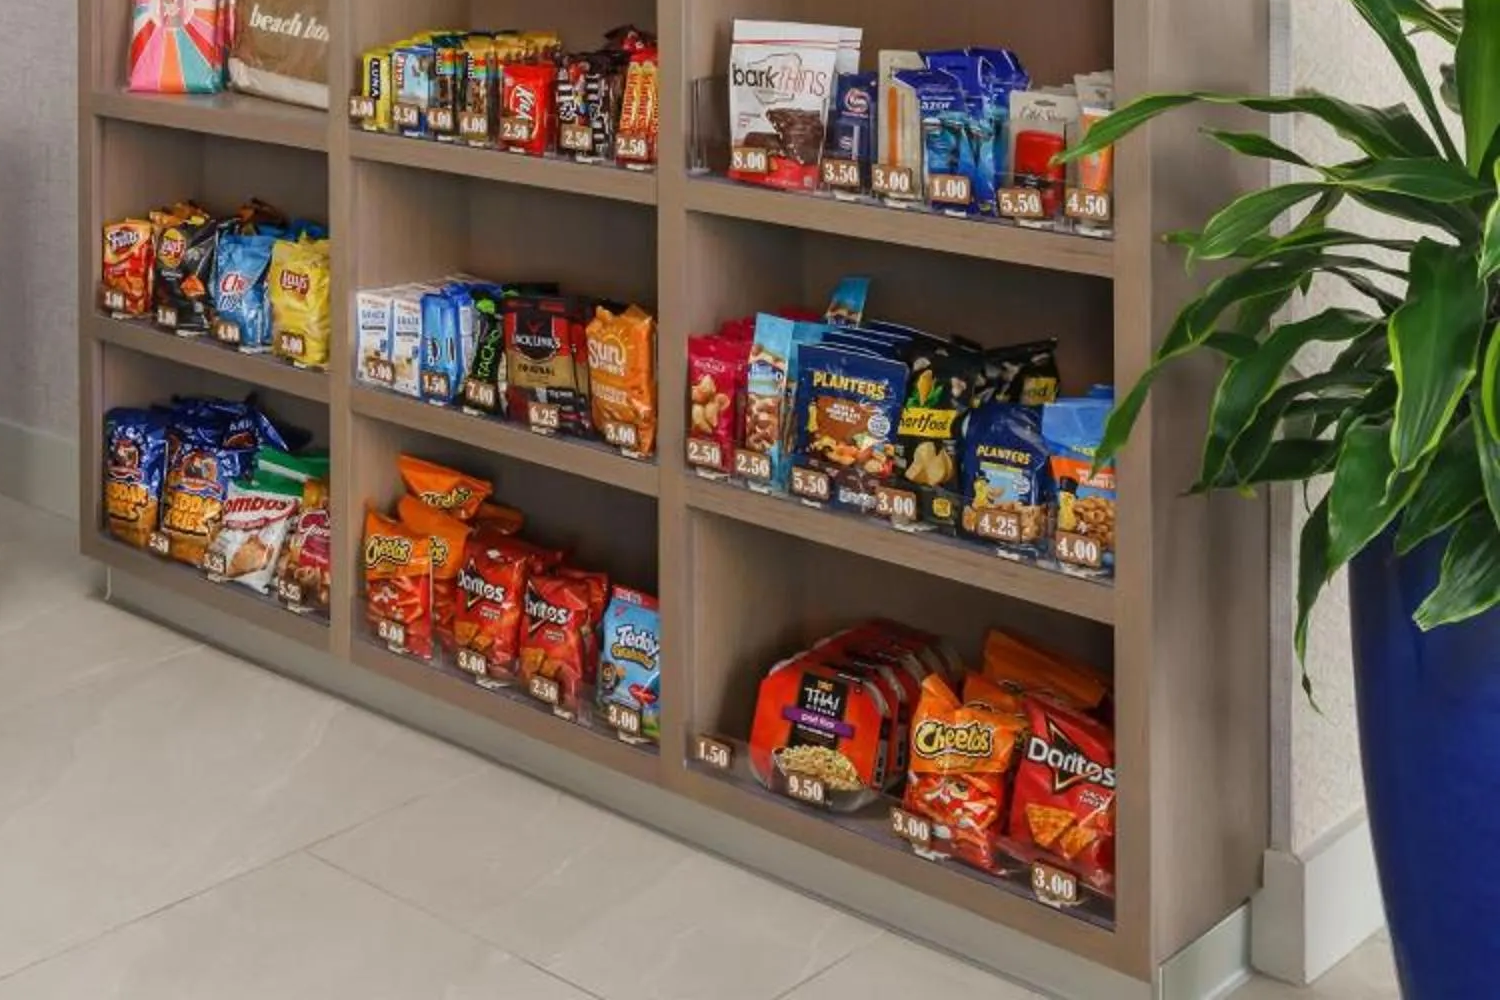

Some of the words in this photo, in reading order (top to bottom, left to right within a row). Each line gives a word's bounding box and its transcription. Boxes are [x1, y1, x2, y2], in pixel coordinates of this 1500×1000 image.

[249, 4, 303, 37] beach
[733, 151, 765, 169] 8.00
[823, 164, 858, 183] 3.50
[874, 169, 909, 191] 3.00
[1001, 193, 1040, 212] 5.50
[1067, 193, 1107, 216] 4.50
[812, 370, 887, 401] PLANTERS
[688, 444, 721, 463] 2.50
[737, 454, 770, 476] 2.50
[975, 445, 1032, 466] PLANTERS
[793, 473, 828, 494] 5.50
[878, 492, 915, 516] 3.00
[979, 513, 1018, 538] 4.25
[1057, 537, 1098, 562] 4.00
[805, 687, 840, 710] THAI
[608, 705, 638, 731] 3.00
[915, 722, 992, 755] Cheetos
[699, 741, 728, 767] 1.50
[1028, 737, 1116, 786] Doritos
[788, 774, 823, 801] 9.50
[891, 812, 929, 840] 3.00
[1033, 867, 1074, 898] 3.00
